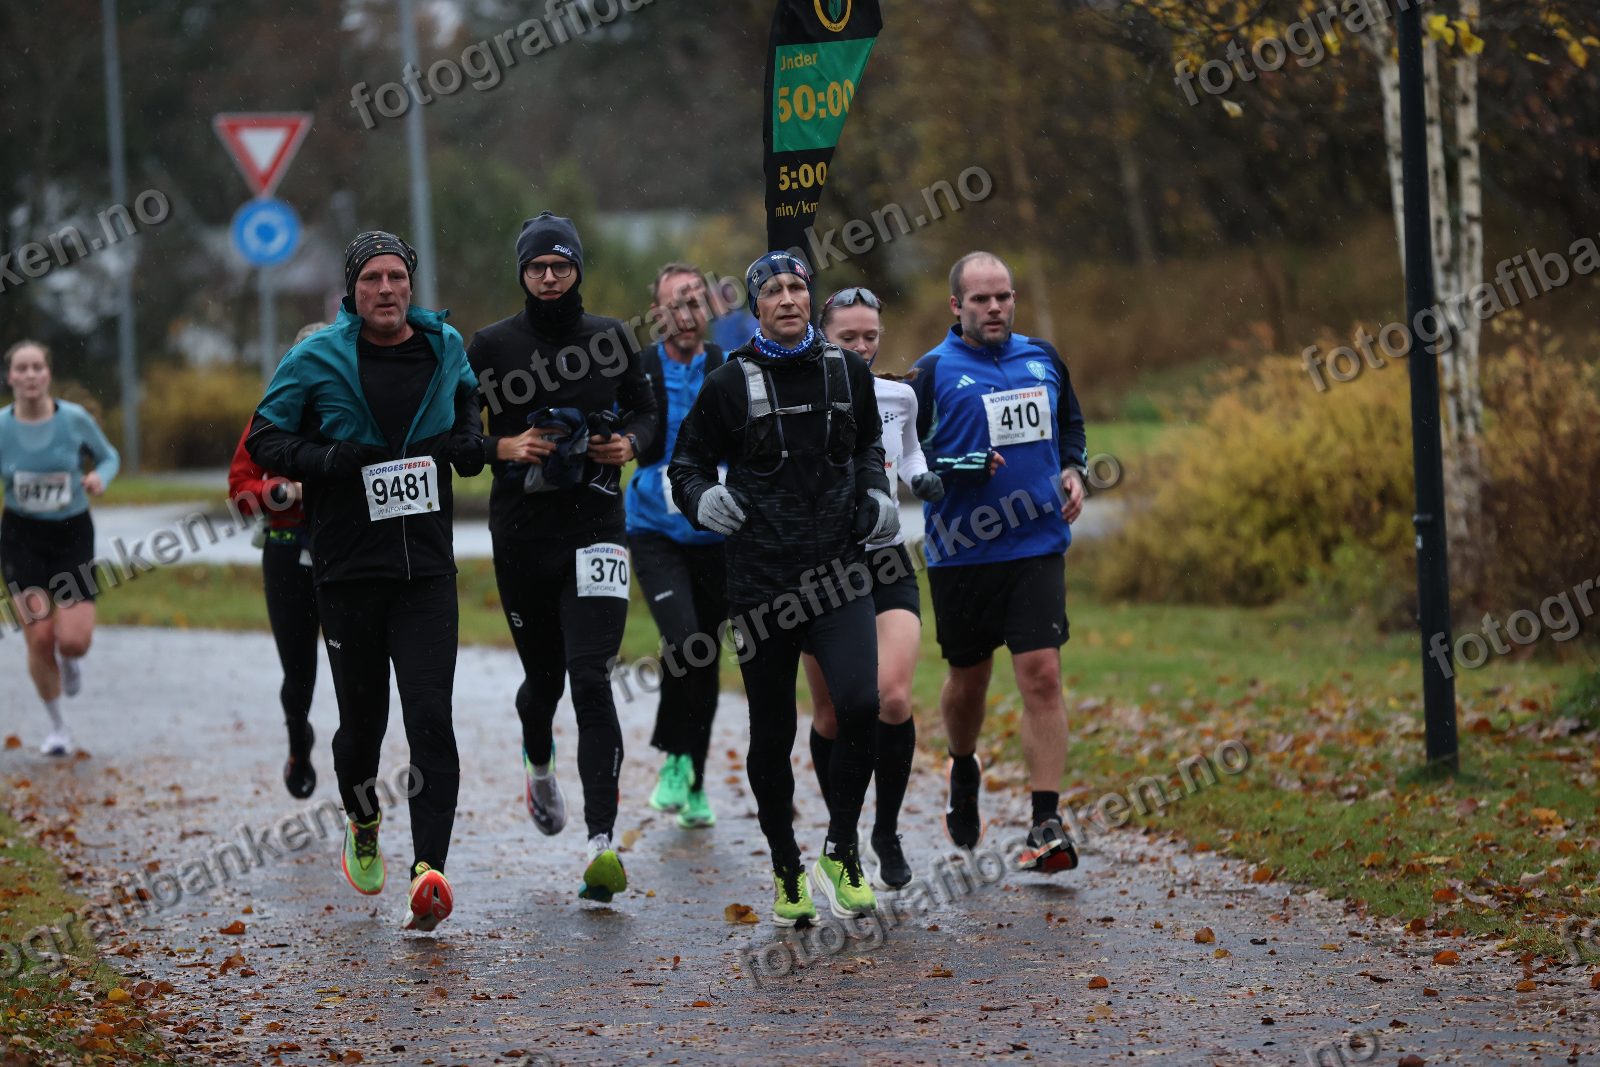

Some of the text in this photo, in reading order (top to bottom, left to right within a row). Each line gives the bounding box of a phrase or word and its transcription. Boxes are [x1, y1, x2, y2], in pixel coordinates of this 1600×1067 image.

[778, 79, 854, 123] 50:00
[778, 161, 827, 191] 5:00
[1001, 401, 1040, 430] 410
[369, 461, 430, 476] NORGESTESTEN
[372, 471, 429, 505] 9481
[591, 558, 627, 586] 370
